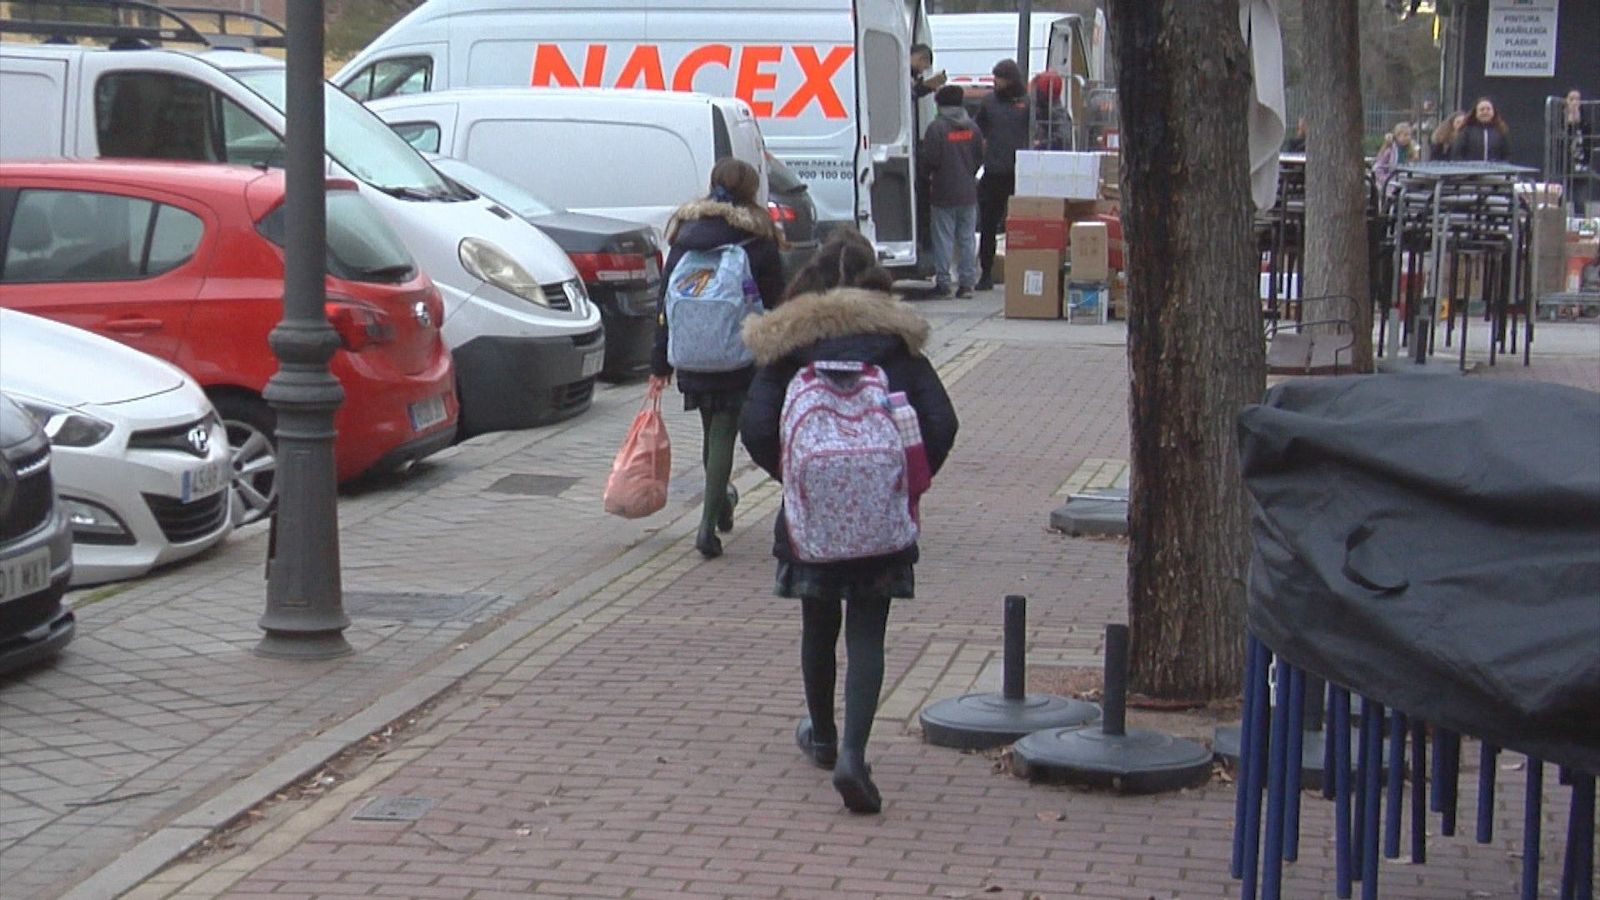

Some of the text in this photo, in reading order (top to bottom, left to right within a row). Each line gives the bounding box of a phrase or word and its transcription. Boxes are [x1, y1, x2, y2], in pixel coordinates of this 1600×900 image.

[1504, 38, 1537, 46] PLADUR
[1491, 61, 1548, 69] ELECTRICIDAD
[531, 43, 856, 119] NACEX
[799, 170, 817, 179] 900
[820, 170, 838, 179] 100
